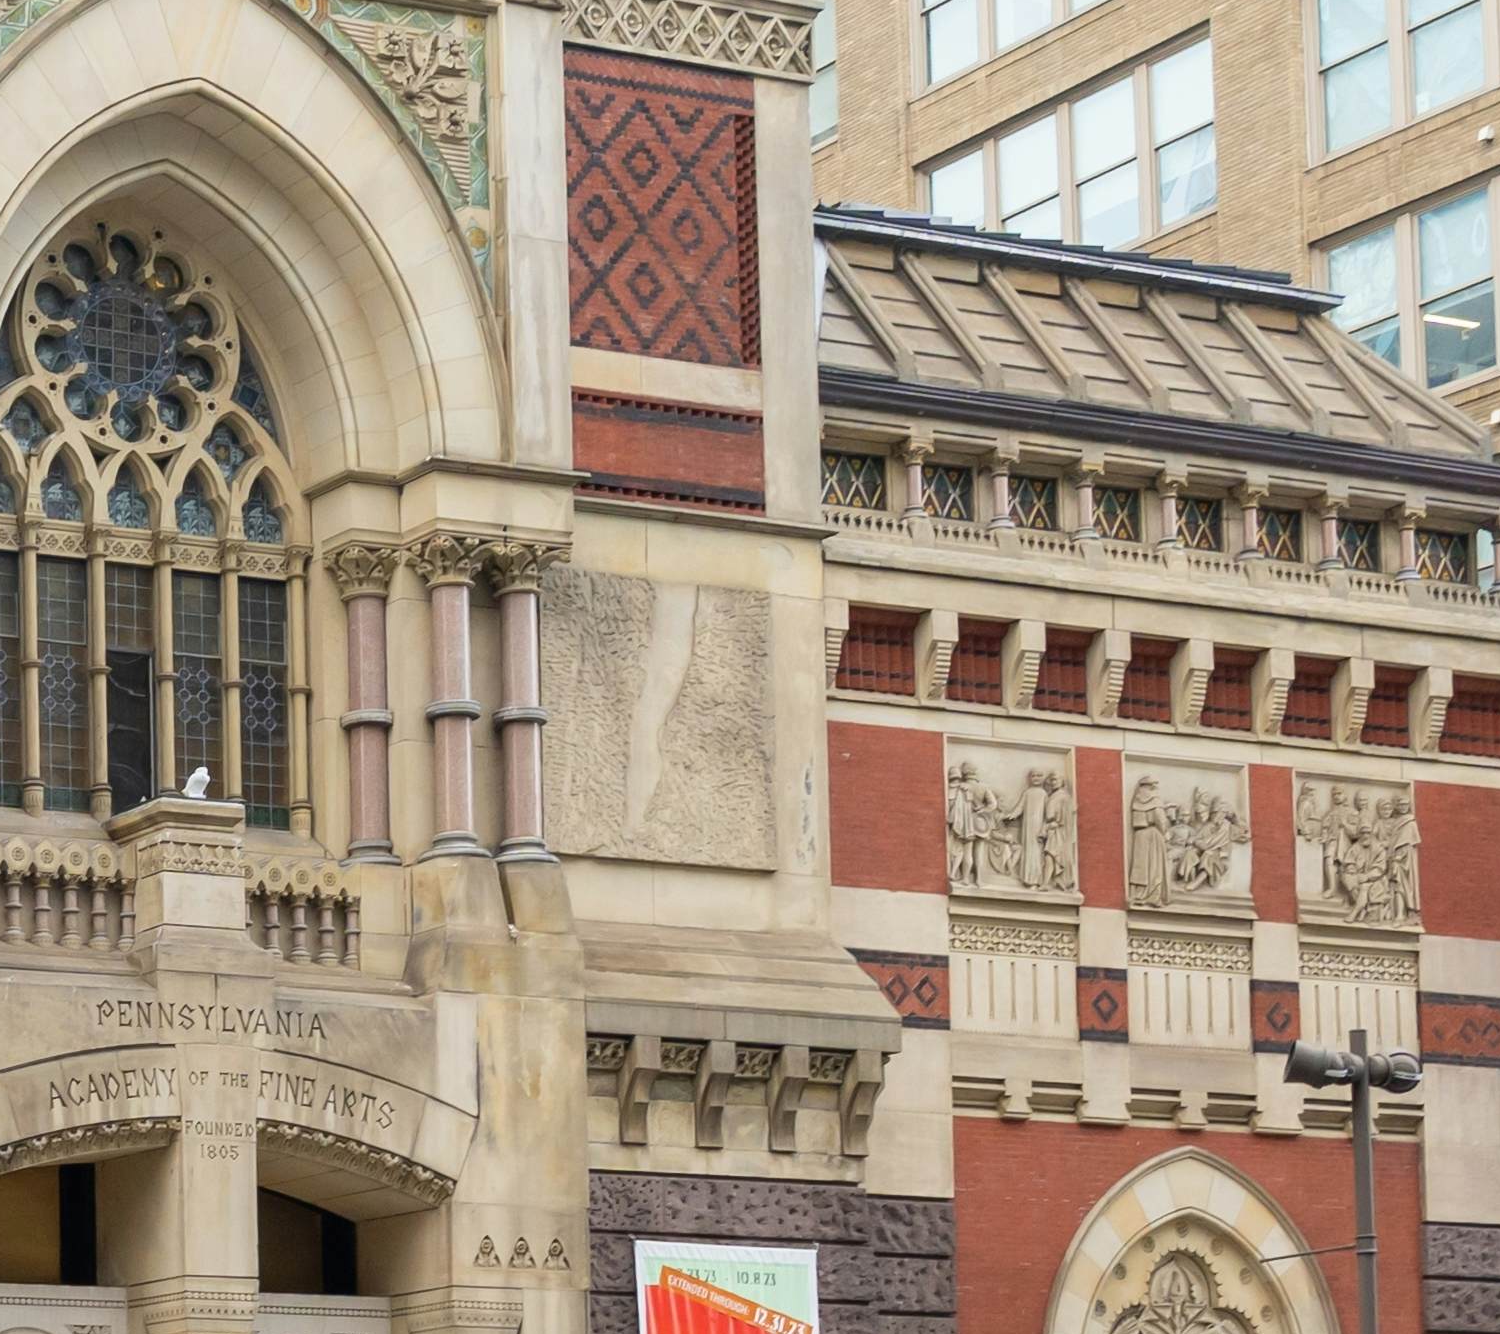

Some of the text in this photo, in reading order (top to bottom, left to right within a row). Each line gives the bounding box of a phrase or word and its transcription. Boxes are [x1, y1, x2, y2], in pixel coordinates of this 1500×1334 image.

[96, 999, 327, 1040] PENNSYLVANIA
[48, 1068, 395, 1129] ACADEMY OF THE FINE ARTS
[184, 1120, 255, 1137] FOUNDED
[200, 1144, 240, 1161] 1805
[667, 1274, 709, 1299] EXTENDED
